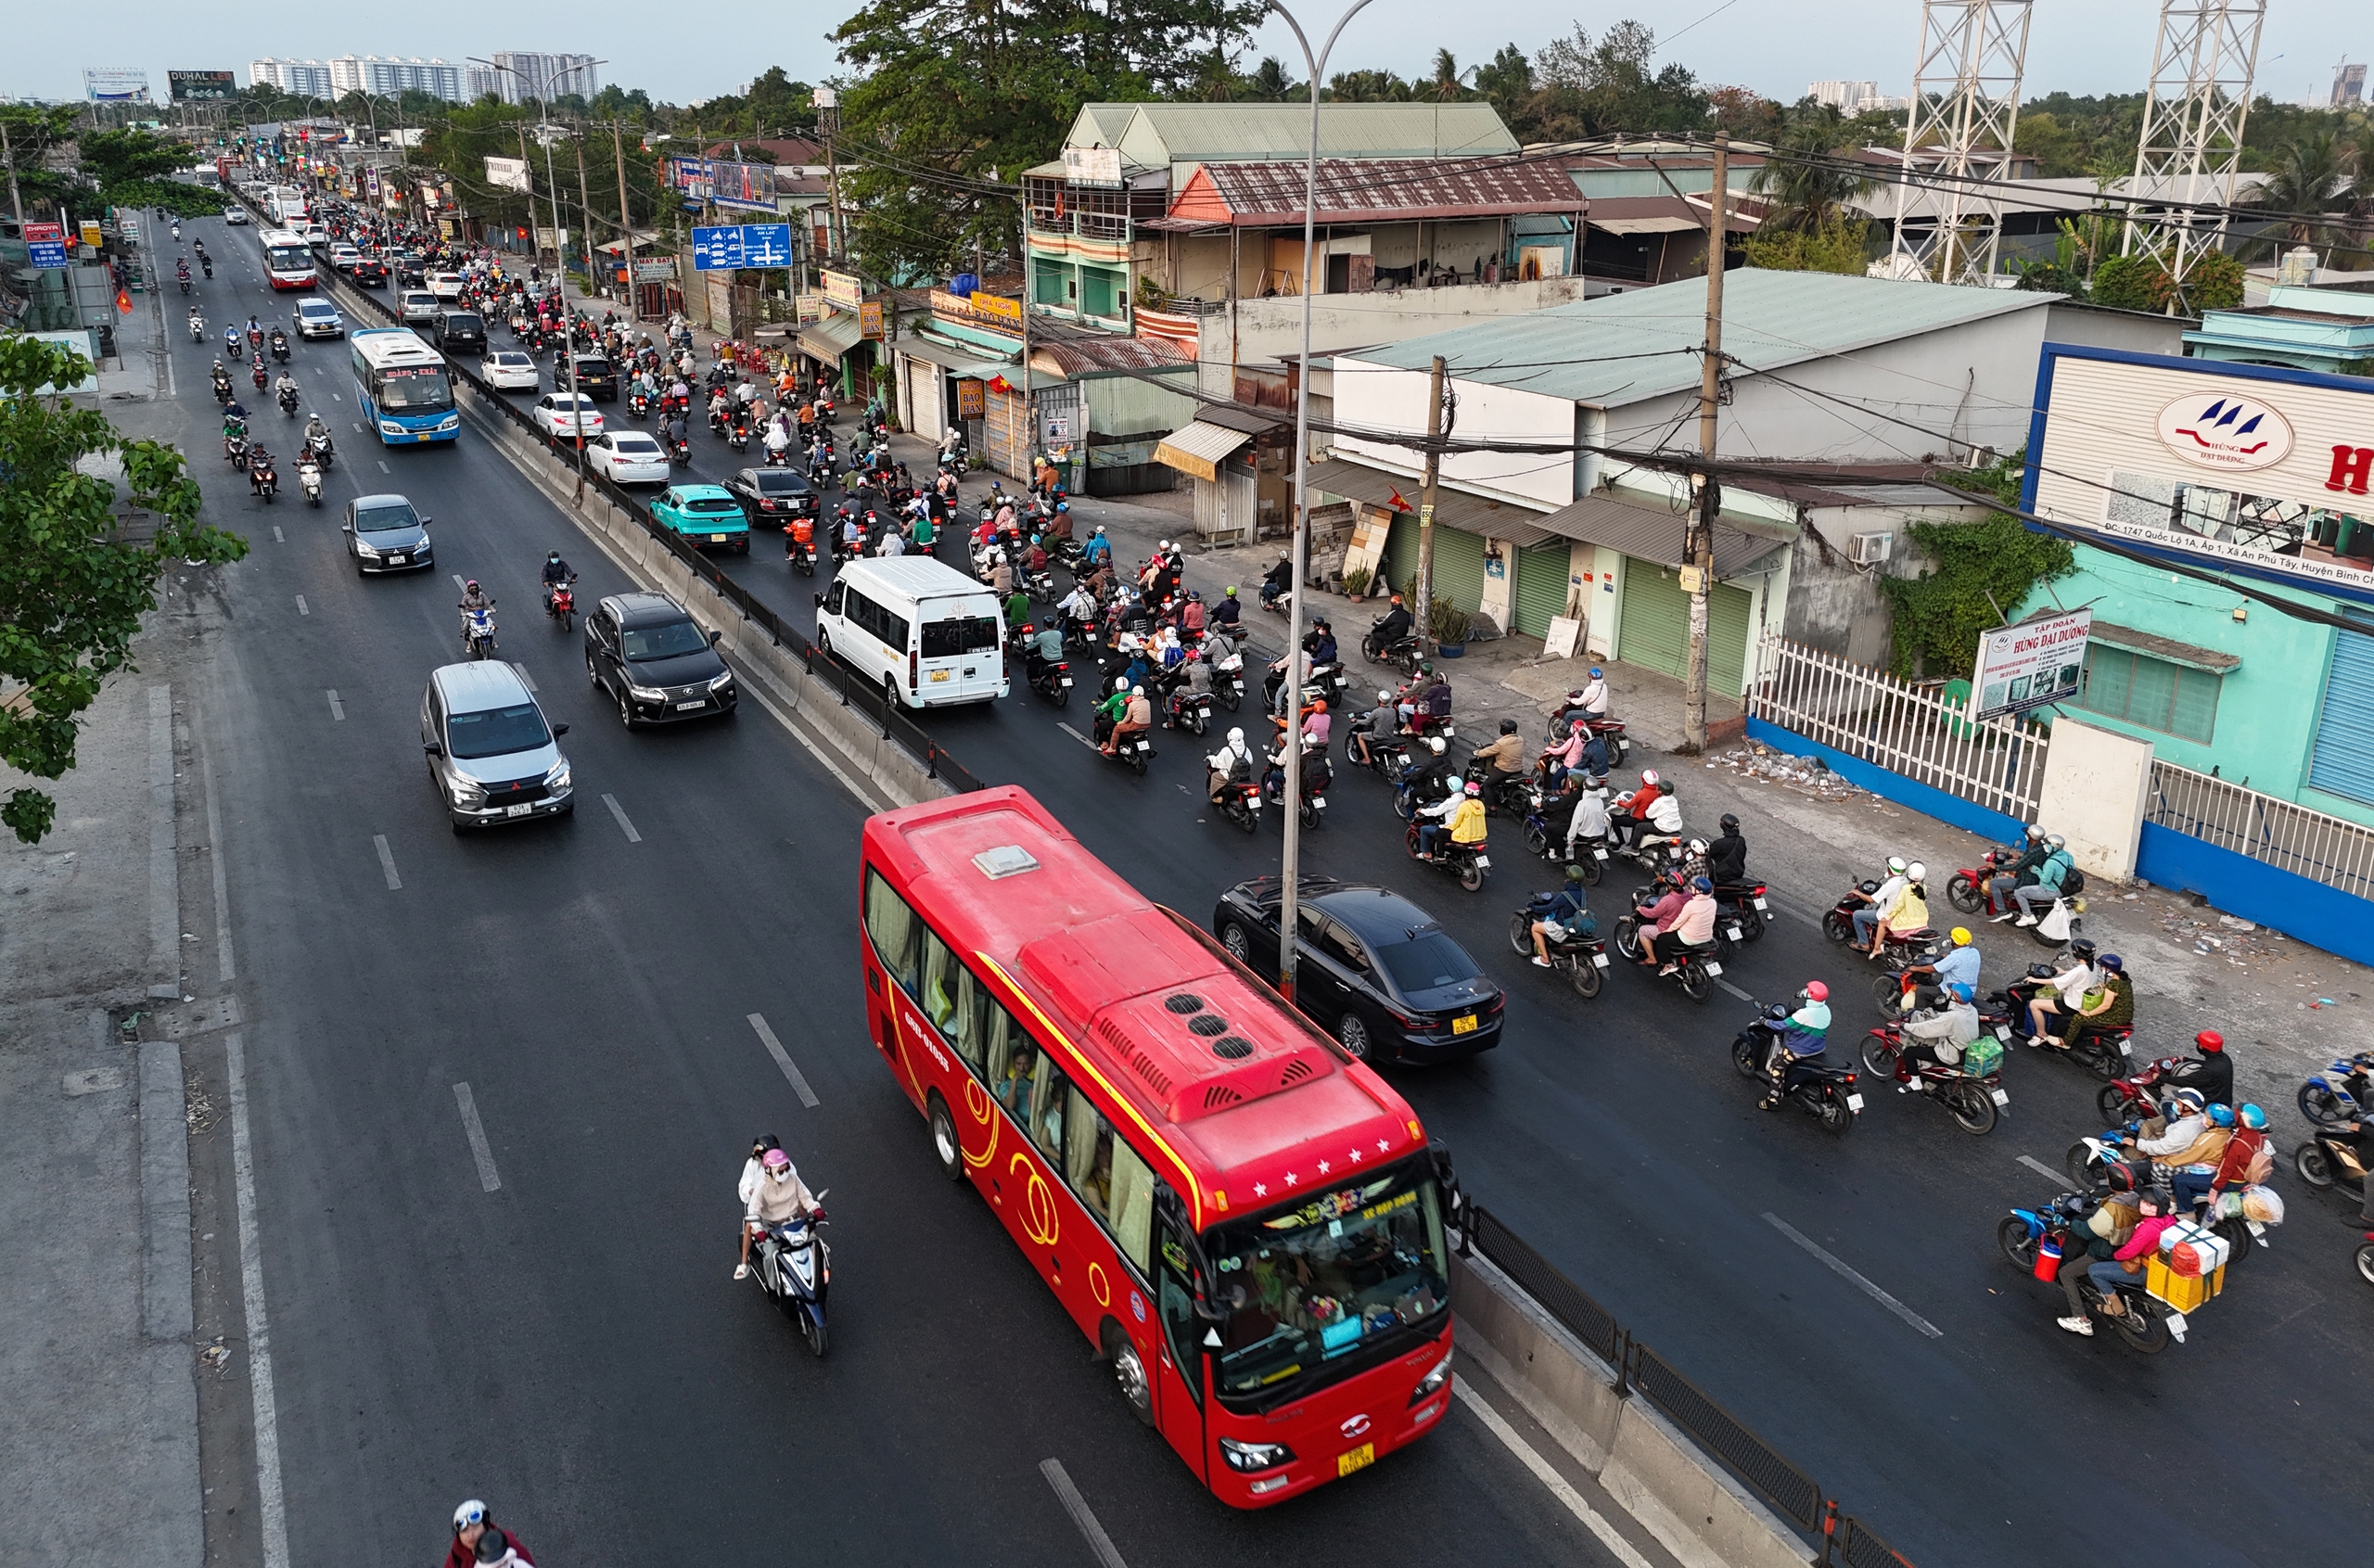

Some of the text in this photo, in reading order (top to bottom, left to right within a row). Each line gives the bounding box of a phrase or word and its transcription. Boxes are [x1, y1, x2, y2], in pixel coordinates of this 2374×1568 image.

[172, 71, 232, 82] DUHAL LED
[2105, 522, 2123, 531] ĐC:
[2124, 526, 2143, 537] 1747
[2145, 531, 2168, 542] Quốc
[2170, 535, 2182, 545] Lộ
[2185, 538, 2199, 549] 1A,
[2217, 545, 2225, 555] 1,
[2227, 546, 2239, 556] Xã
[2241, 549, 2254, 560] An
[2257, 553, 2277, 565] Phú
[2279, 557, 2299, 570] Tây,
[2301, 562, 2333, 577] Huyện
[2335, 569, 2360, 581] Bình
[2035, 624, 2051, 633] TẬP
[2013, 624, 2088, 654] HÙNG ĐẠI DƯƠNG
